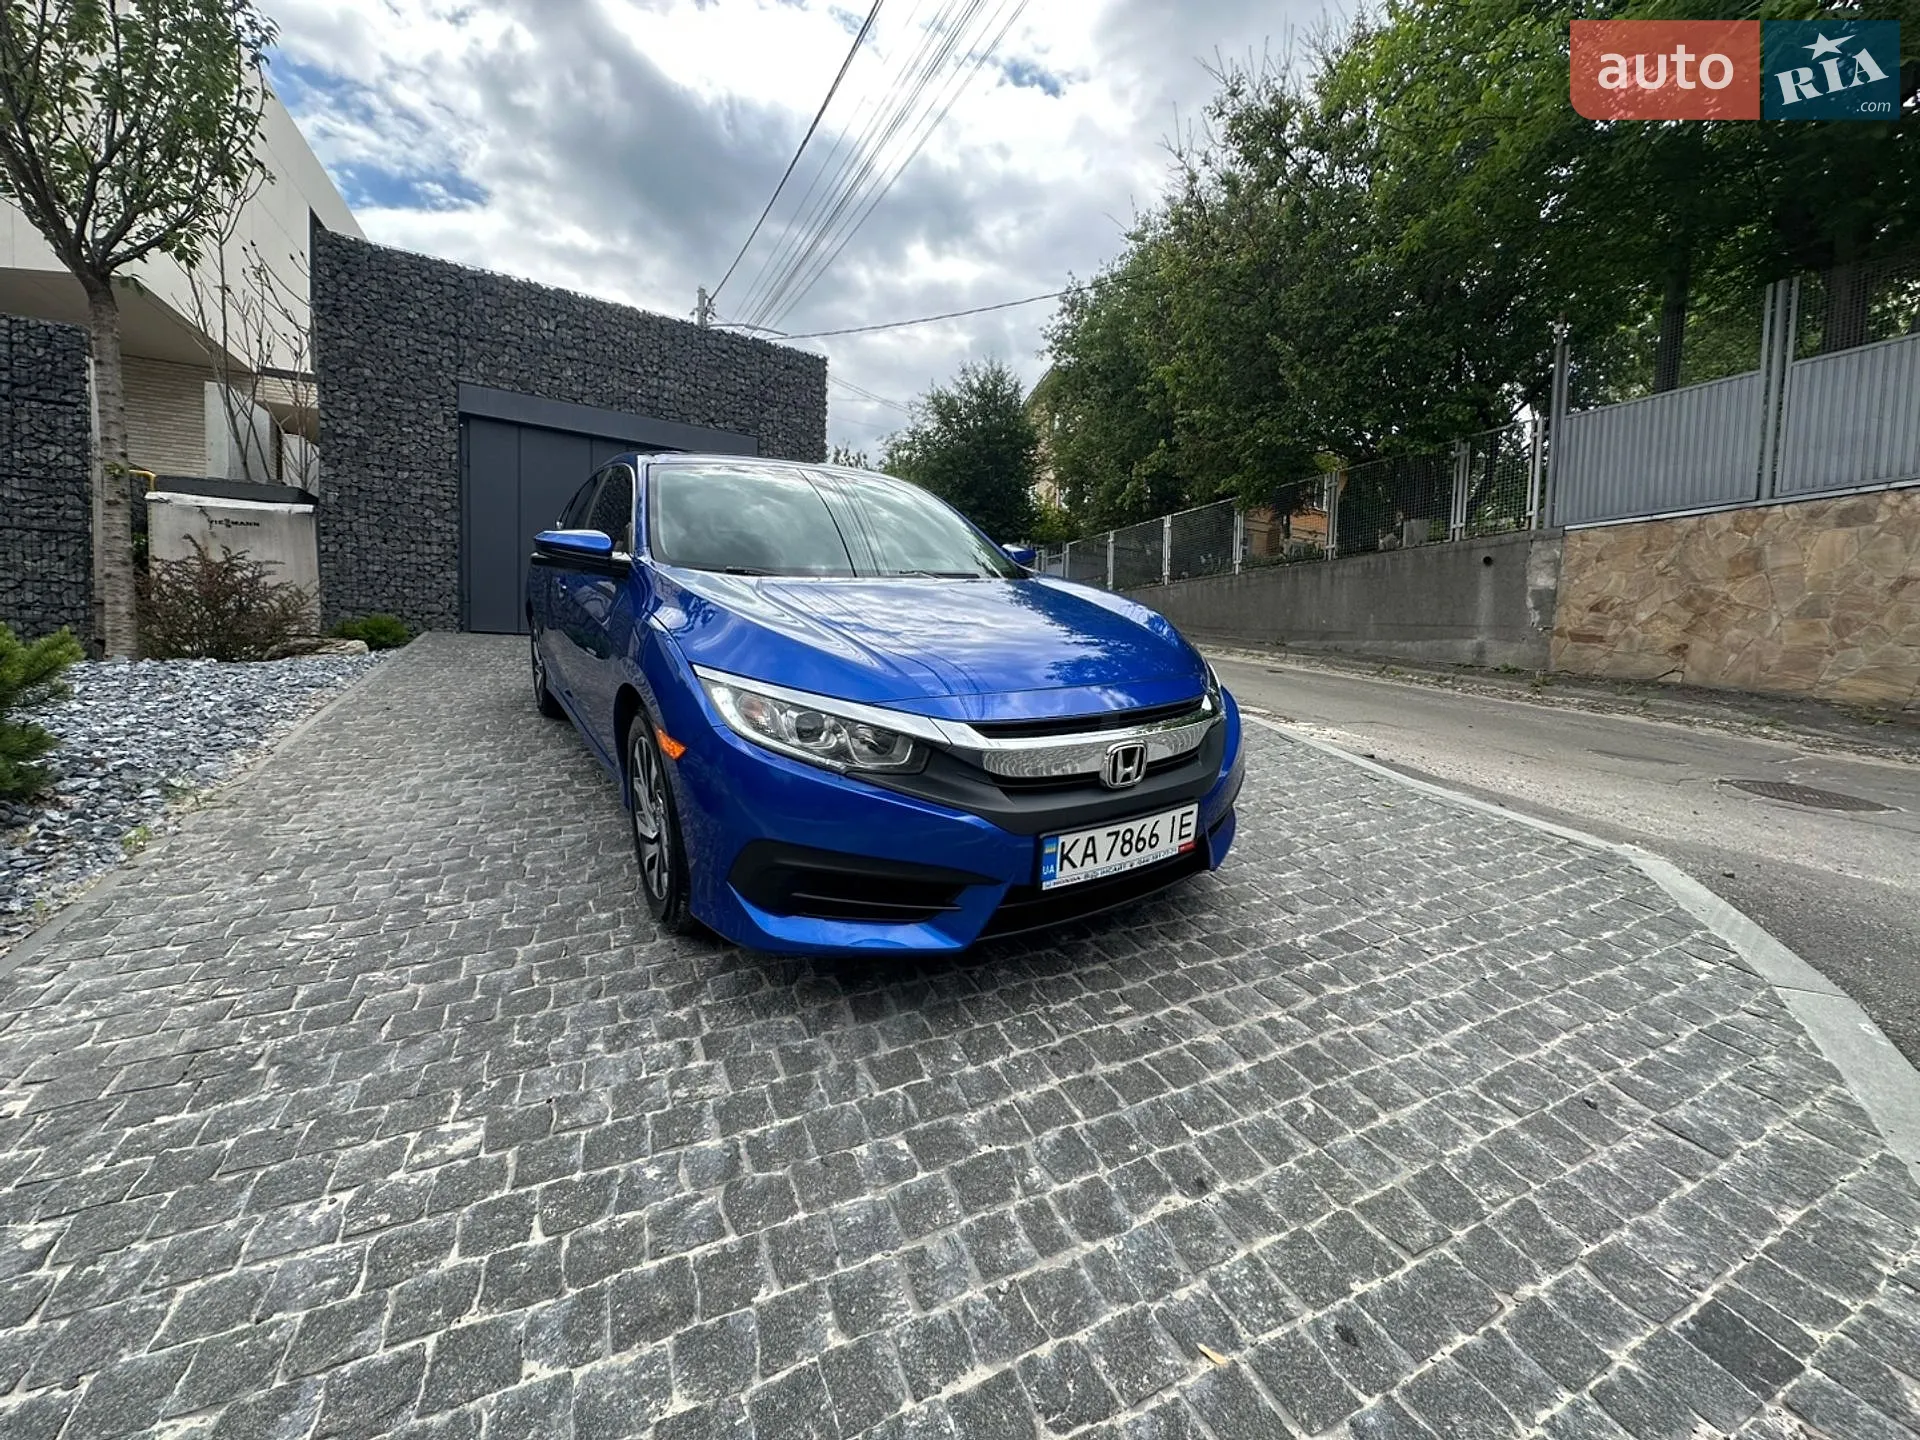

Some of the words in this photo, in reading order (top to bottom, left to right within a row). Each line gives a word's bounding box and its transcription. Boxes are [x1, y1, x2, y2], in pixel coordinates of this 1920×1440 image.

[1059, 835, 1097, 871] KA
[1106, 820, 1160, 861] 7866
[1169, 810, 1194, 843] IE
[1042, 865, 1055, 875] UA
